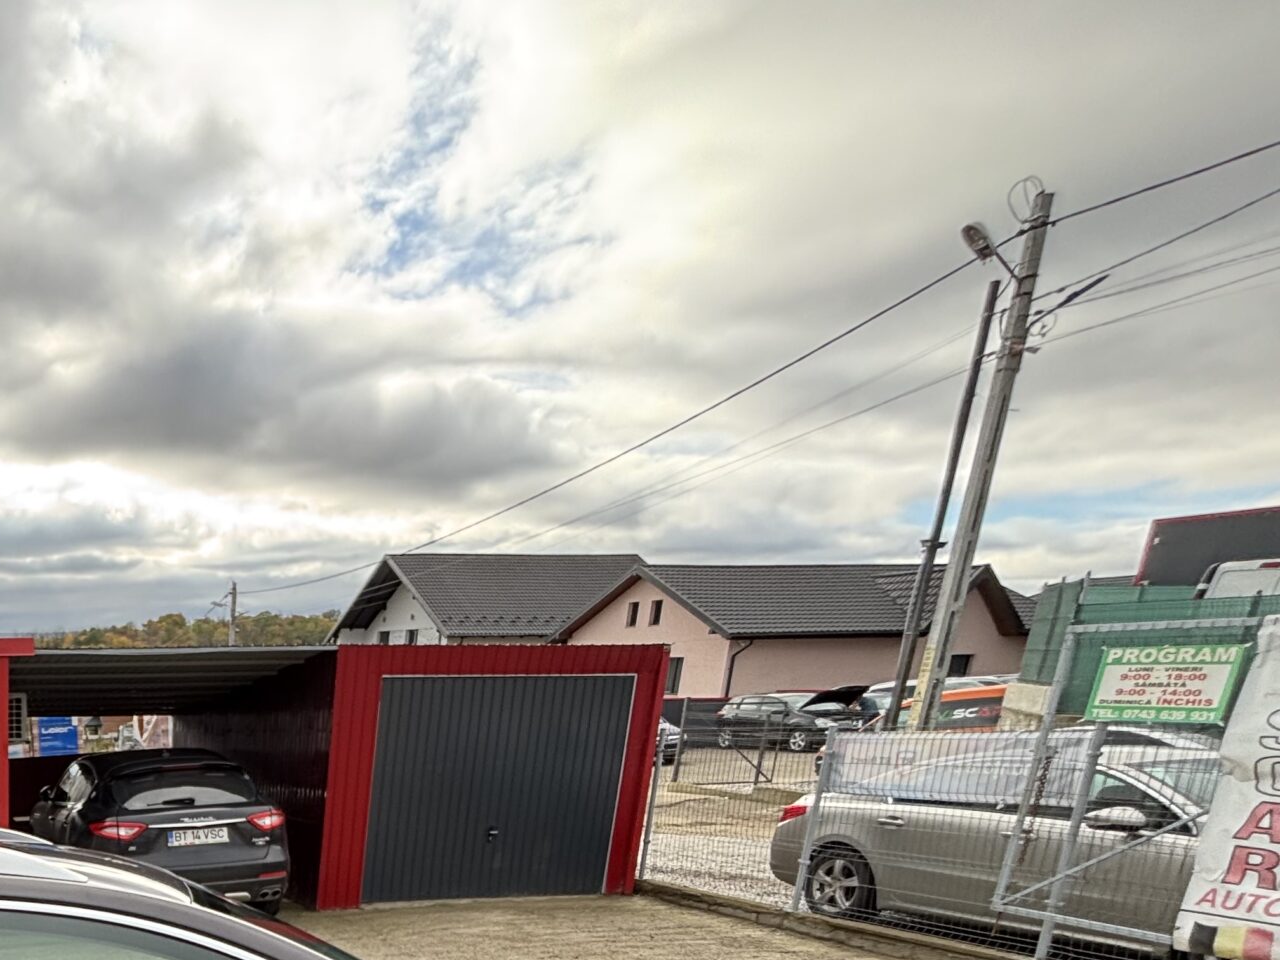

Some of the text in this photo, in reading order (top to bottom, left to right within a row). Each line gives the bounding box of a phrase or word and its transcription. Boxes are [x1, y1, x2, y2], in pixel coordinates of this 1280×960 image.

[1106, 646, 1238, 663] PROGRAM
[1120, 673, 1151, 681] 9:00
[1167, 673, 1208, 681] 18:00
[1115, 688, 1146, 696] 9:00
[1160, 689, 1202, 697] 14:00
[174, 831, 188, 842] BT
[203, 828, 225, 840] VSC
